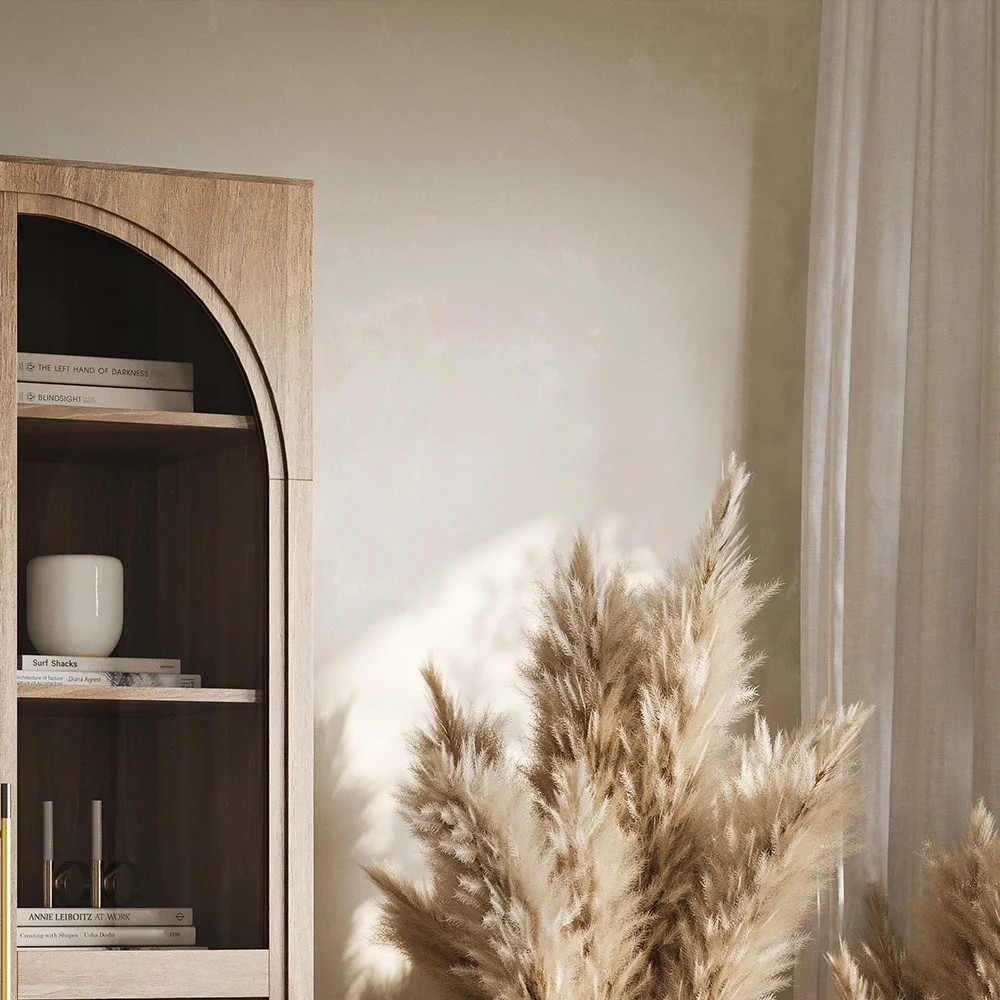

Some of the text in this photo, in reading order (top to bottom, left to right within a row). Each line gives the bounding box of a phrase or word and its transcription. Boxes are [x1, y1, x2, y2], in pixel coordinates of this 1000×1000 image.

[38, 363, 51, 372] THE
[55, 364, 70, 373] LEFT
[73, 365, 95, 374] HAND
[98, 367, 109, 375] OF
[111, 368, 149, 378] DARKNESS
[38, 393, 82, 403] BLINDSIGHT
[32, 658, 78, 668] Surf Shacks
[68, 675, 84, 683] Diana
[28, 913, 131, 921] ANNIE LEIBOITZ AT WORK
[19, 932, 44, 941] Creating
[45, 931, 58, 939] with
[58, 931, 79, 940] Shapes
